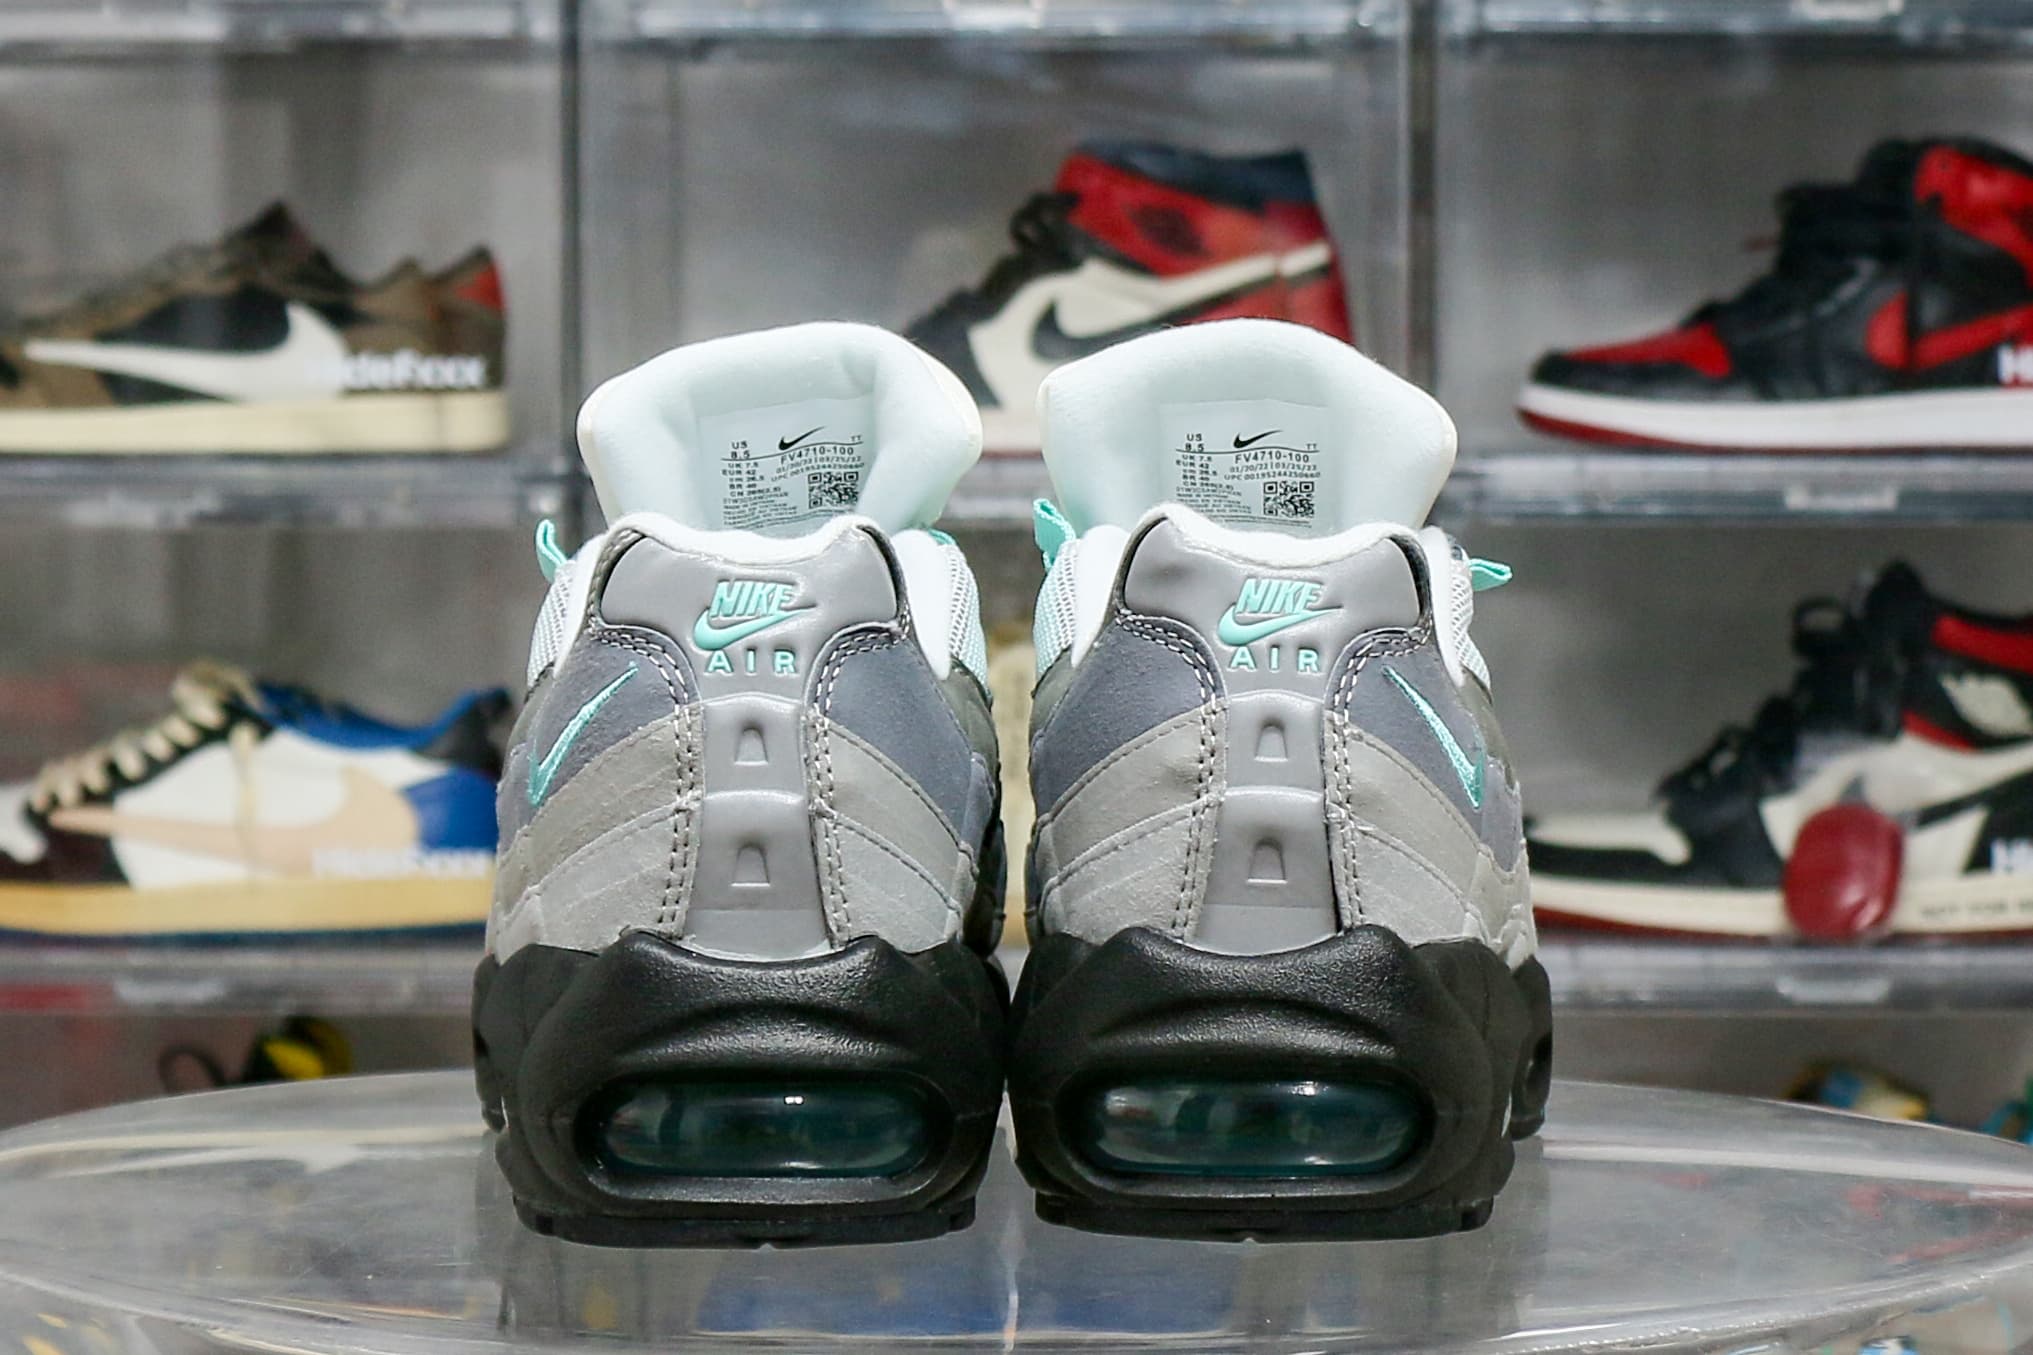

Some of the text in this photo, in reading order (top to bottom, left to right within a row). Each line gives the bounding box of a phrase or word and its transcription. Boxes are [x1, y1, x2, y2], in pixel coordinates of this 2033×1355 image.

[731, 440, 748, 450] US
[1186, 433, 1202, 442] US
[730, 450, 750, 460] 8.5
[780, 446, 854, 464] FV4710-100
[1185, 443, 1205, 453] 8.5
[1234, 450, 1310, 464] FV4710-100
[709, 580, 796, 617] NIKE
[1234, 578, 1323, 614] NIKE
[706, 649, 796, 673] AIR
[1230, 646, 1319, 672] AIR
